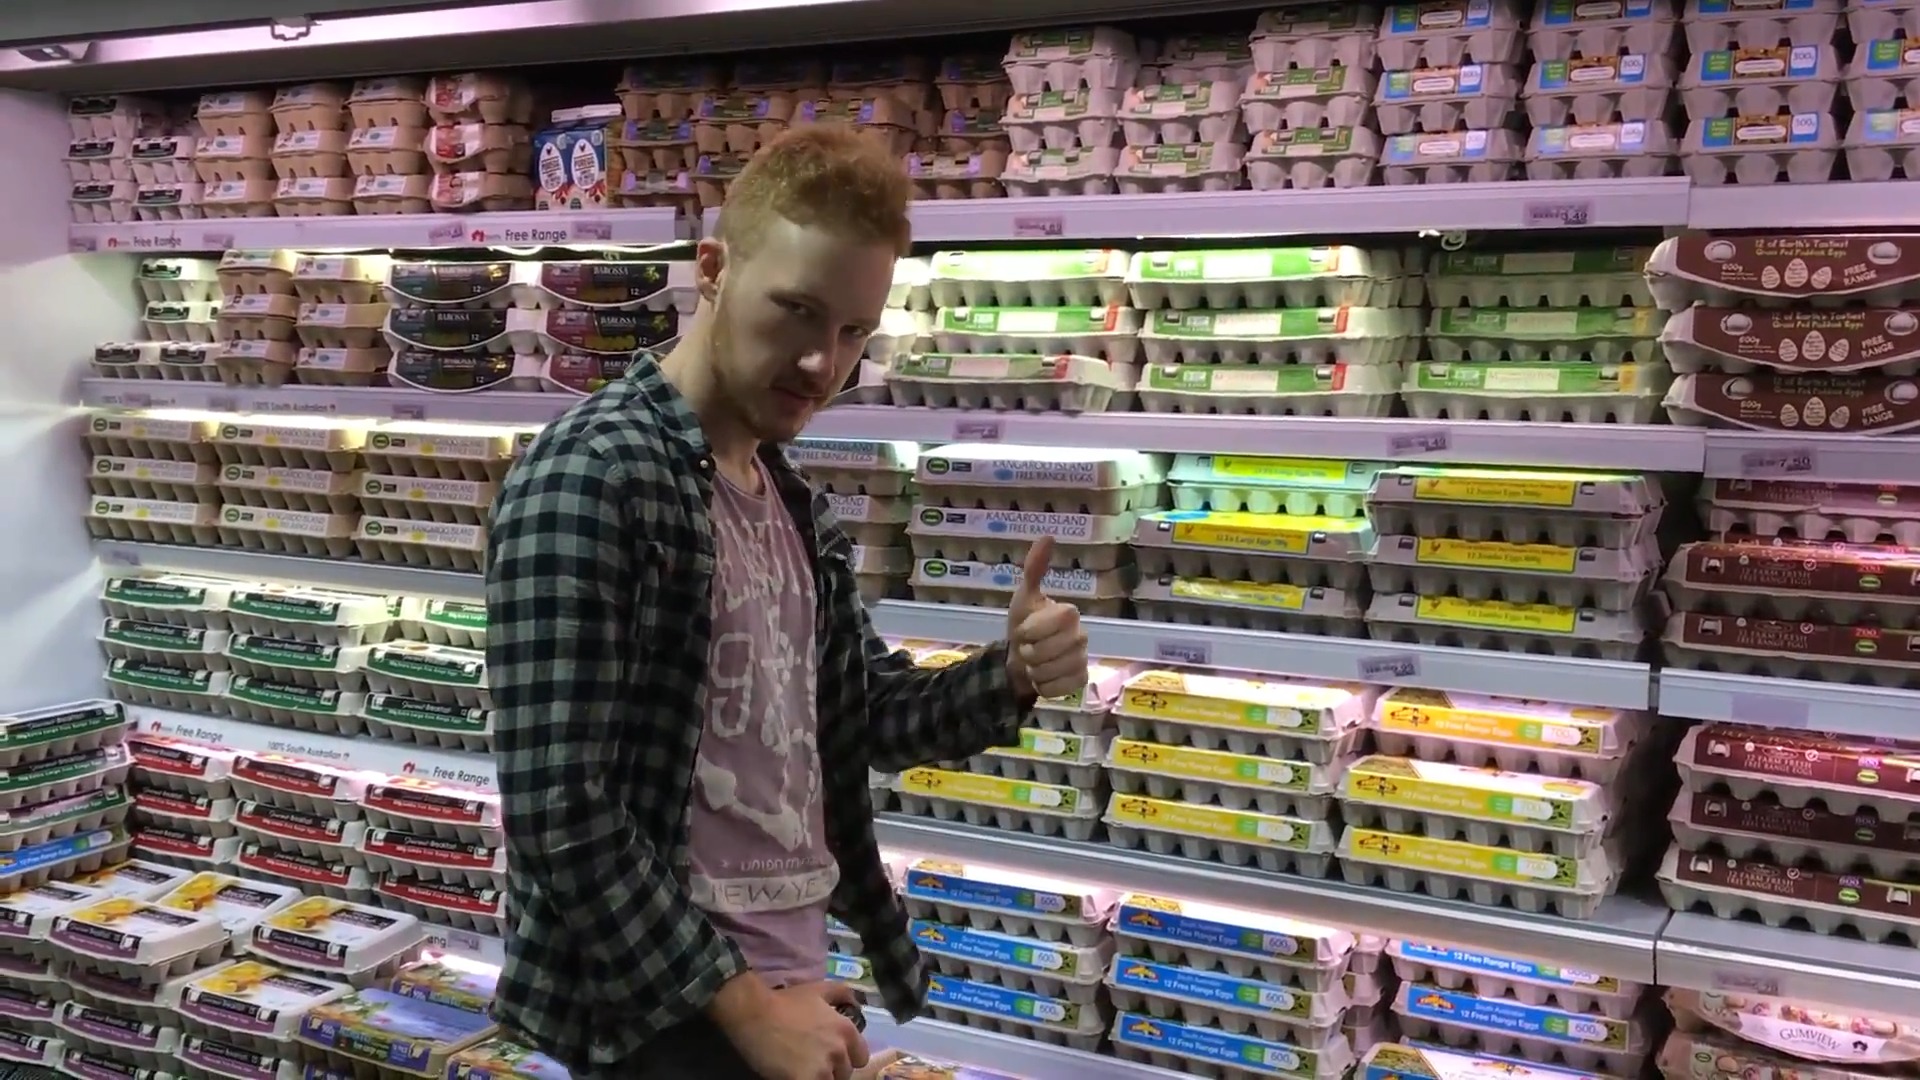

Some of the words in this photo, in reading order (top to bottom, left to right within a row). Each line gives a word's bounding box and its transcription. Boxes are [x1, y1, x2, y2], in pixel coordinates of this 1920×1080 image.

[133, 236, 151, 247] Free
[154, 236, 181, 248] Range
[505, 229, 529, 240] Free
[531, 229, 567, 242] Range
[1767, 240, 1778, 248] of
[1827, 249, 1847, 257] Eggs
[1721, 263, 1743, 273] 600g
[1844, 263, 1868, 276] FREE
[1843, 270, 1877, 286] RANGE
[1844, 321, 1864, 330] Eggs
[1861, 335, 1886, 349] FREE
[1861, 342, 1895, 359] RANGE
[1862, 403, 1885, 416] FREE
[1862, 410, 1895, 425] RANGE
[1053, 462, 1094, 472] ISLAND
[1015, 471, 1034, 480] FREE
[1037, 472, 1067, 481] RANGE
[1069, 473, 1093, 482] EGGS
[986, 511, 1046, 523] KANGAROO
[1049, 514, 1087, 525] ISLAND
[1009, 525, 1027, 534] FREE
[1030, 526, 1058, 535] RANGE
[1062, 527, 1086, 536] EGGS
[1053, 569, 1092, 580] ISLAND
[1067, 580, 1091, 591] EGGS
[175, 725, 195, 737] Free
[196, 729, 223, 742] Range
[286, 744, 305, 754] South
[307, 747, 342, 758] Australian
[1758, 755, 1781, 764] FARM
[433, 767, 454, 779] Free
[457, 771, 490, 786] Range
[959, 890, 974, 899] Free
[974, 891, 994, 902] Range
[995, 893, 1013, 905] Eggs
[1167, 926, 1175, 935] 12
[1177, 927, 1192, 937] Free
[1194, 930, 1218, 943] Range
[1219, 934, 1238, 946] Eggs
[950, 941, 958, 950] 12
[958, 943, 973, 953] Free
[973, 945, 993, 957] Range
[994, 950, 1011, 961] Eggs
[1453, 951, 1463, 961] 12
[1464, 953, 1482, 964] Free
[1483, 957, 1510, 970] Range
[1511, 961, 1533, 974] Eggs
[1164, 979, 1172, 988] 12
[1173, 981, 1189, 991] Free
[1190, 984, 1215, 996] Range
[1215, 988, 1234, 1000] Eggs
[949, 991, 957, 1000] 12
[957, 993, 972, 1003] Free
[973, 996, 993, 1007] Range
[994, 999, 1012, 1011] Eggs
[1461, 1010, 1470, 1018] 12
[1471, 1011, 1490, 1022] Free
[1491, 1014, 1517, 1027] Range
[1518, 1019, 1539, 1031] Eggs
[1779, 1028, 1842, 1050] GUMVIEW
[1168, 1036, 1176, 1045] 12
[1177, 1038, 1194, 1049] Free
[1195, 1042, 1219, 1055] Range
[1220, 1045, 1239, 1058] Eggs
